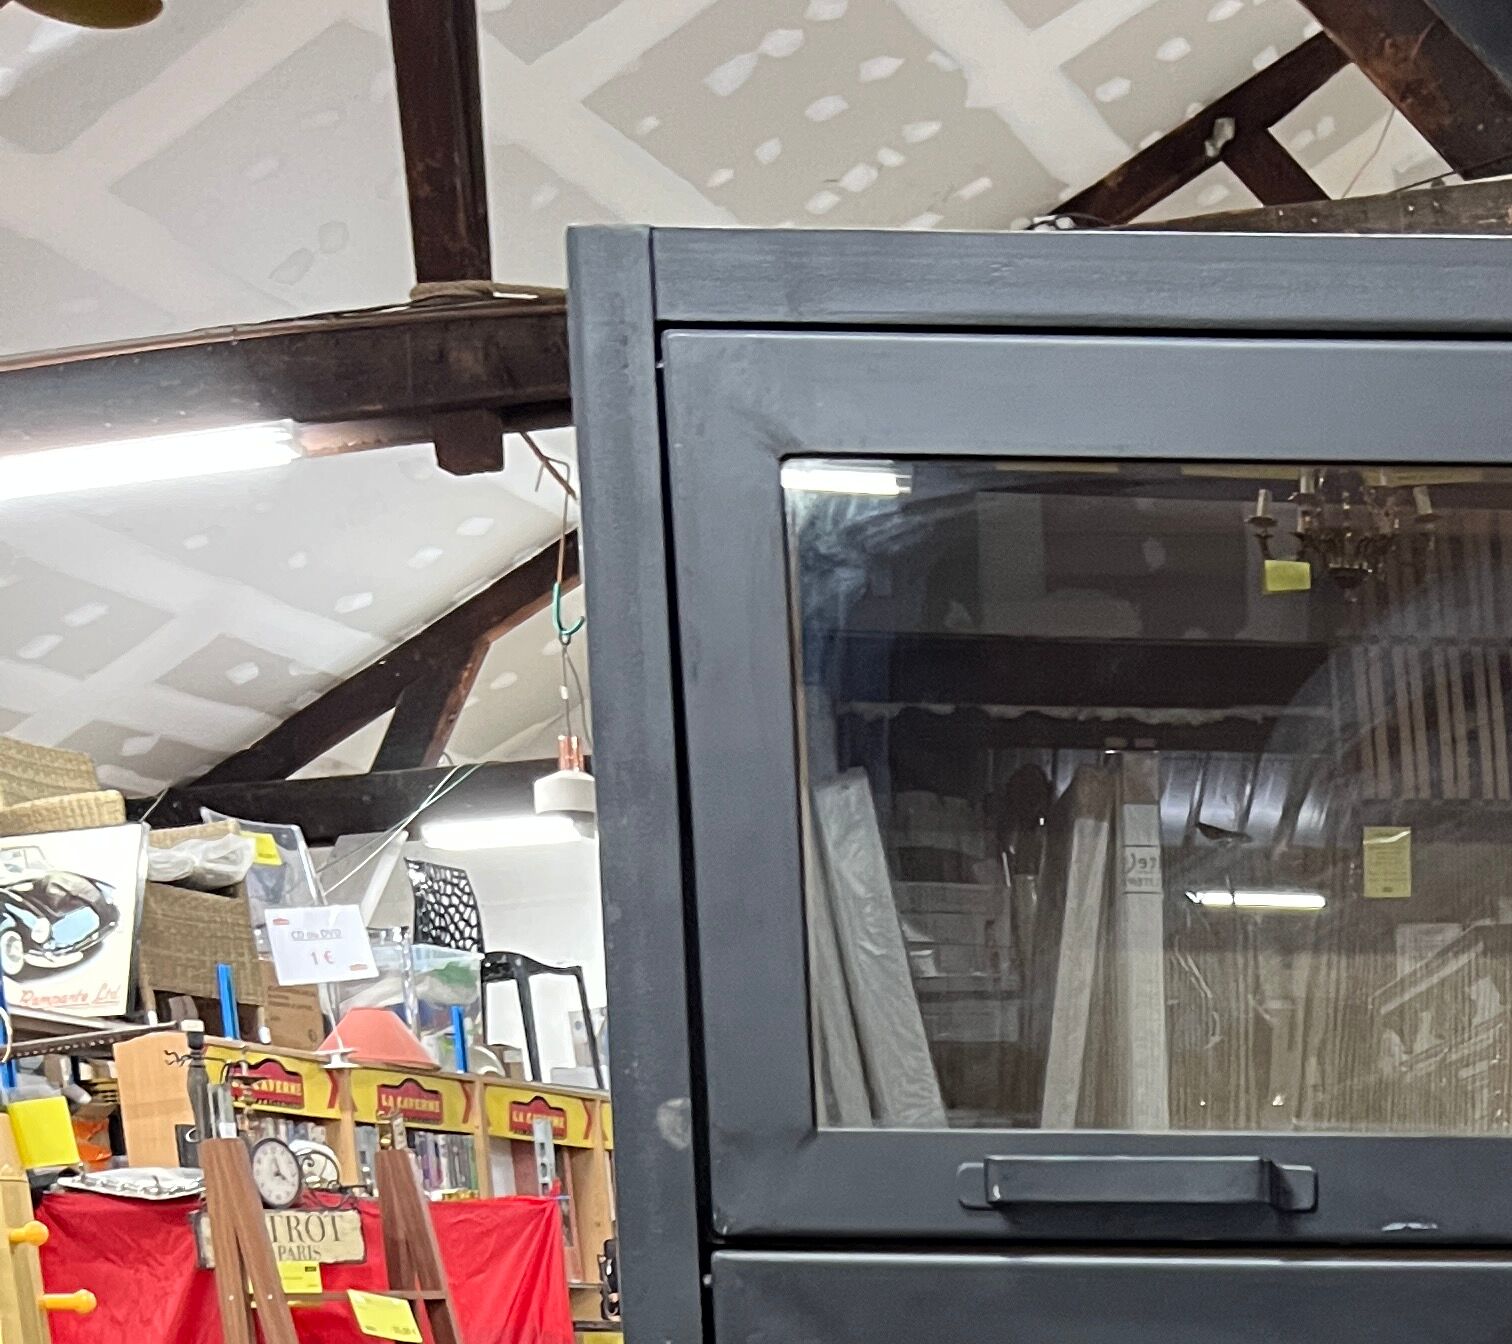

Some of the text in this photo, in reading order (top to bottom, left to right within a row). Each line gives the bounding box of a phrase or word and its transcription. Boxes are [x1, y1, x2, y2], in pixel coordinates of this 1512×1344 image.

[311, 950, 335, 966] 1 €
[266, 1213, 344, 1244] TROT
[277, 1245, 322, 1262] PARIS
